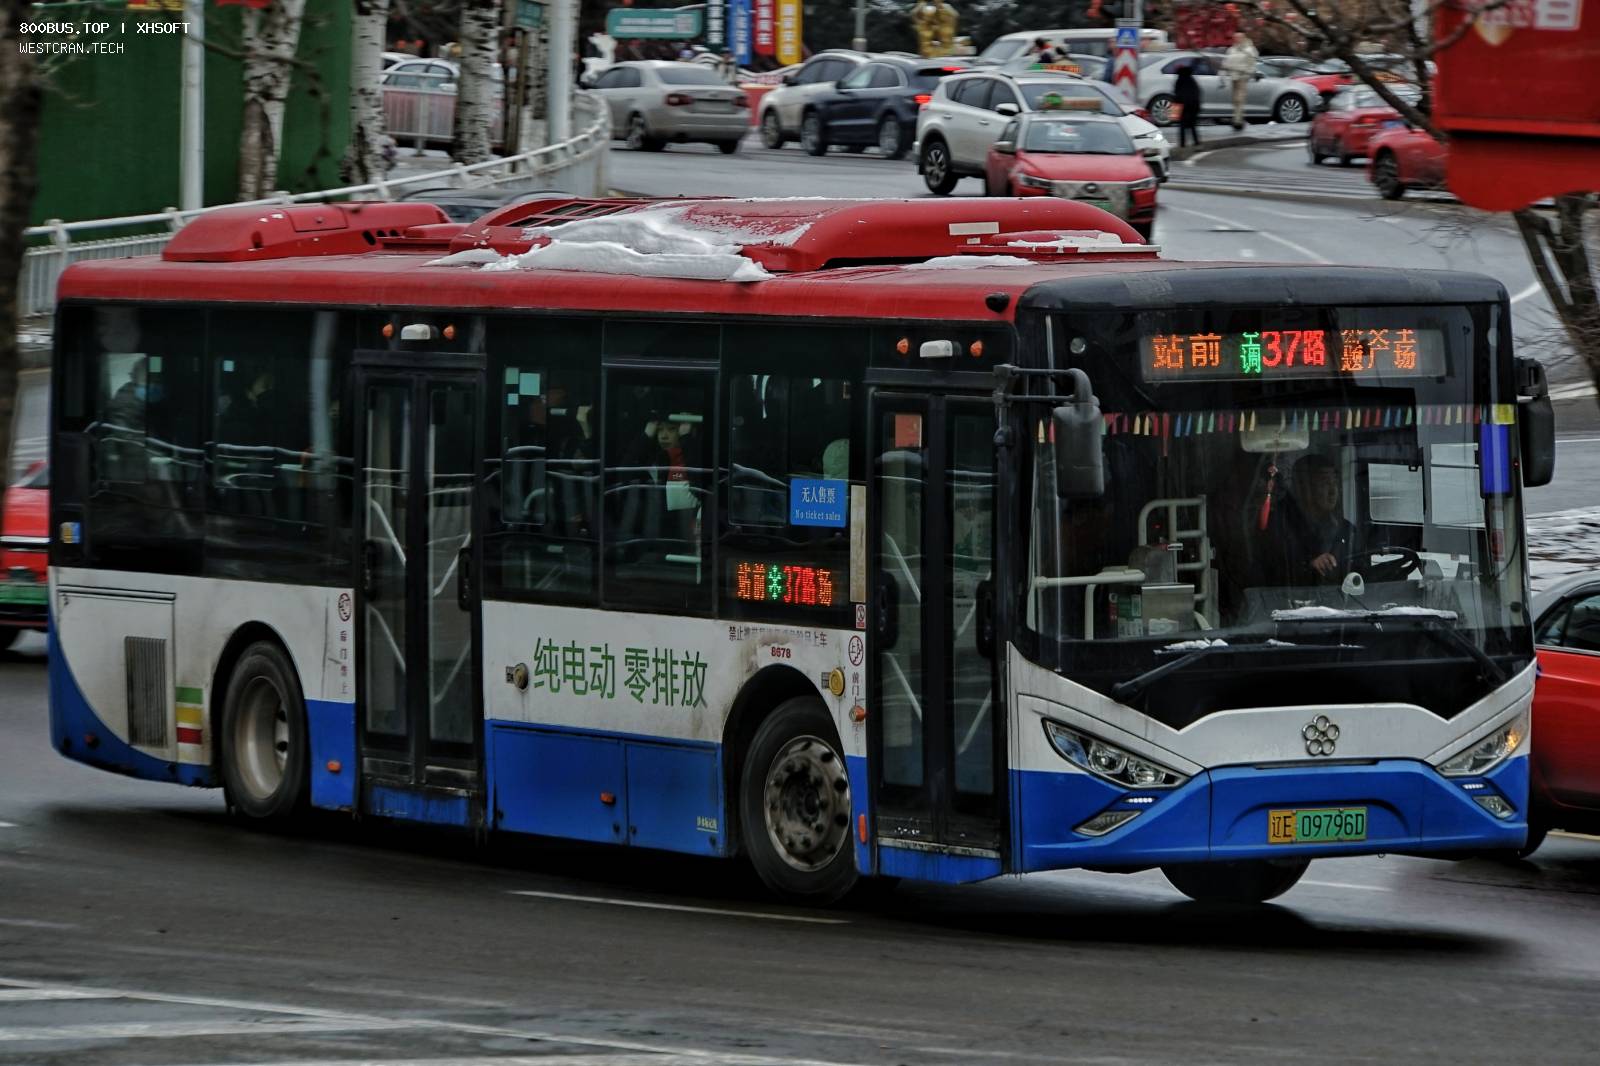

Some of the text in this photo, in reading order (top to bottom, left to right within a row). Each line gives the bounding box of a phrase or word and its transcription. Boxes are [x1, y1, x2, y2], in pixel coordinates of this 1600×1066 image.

[1152, 332, 1222, 369] 站前
[1262, 330, 1325, 368] 37路
[801, 486, 836, 504] 无人售票
[795, 509, 804, 519] No
[806, 509, 824, 520] ticket
[771, 646, 792, 659] 8678
[533, 637, 709, 709] 纯电动 零排放
[1301, 813, 1365, 837] 09796D
